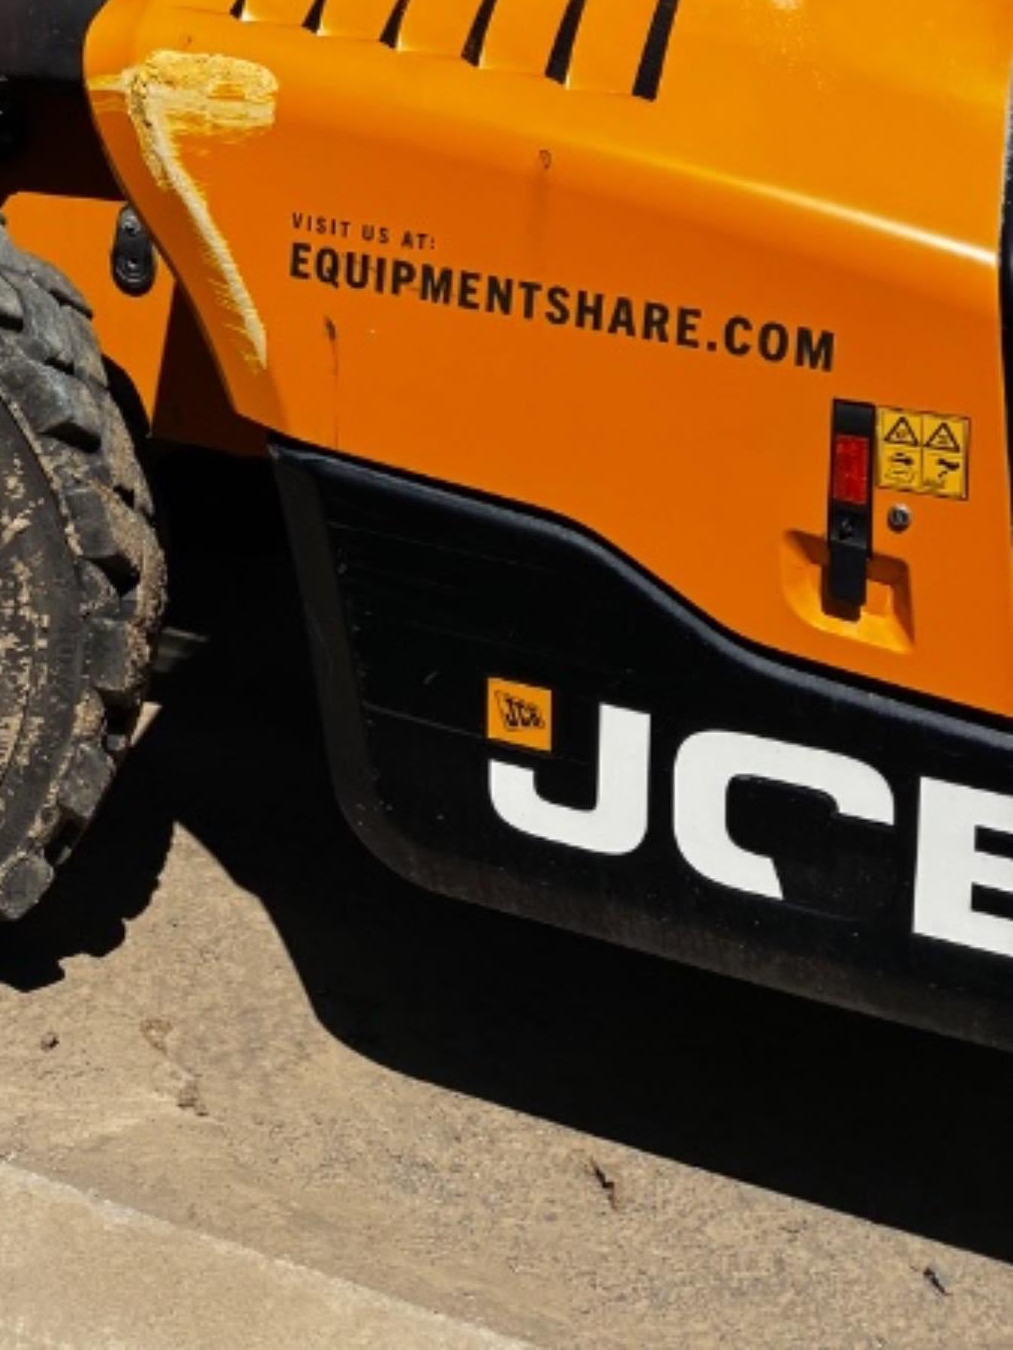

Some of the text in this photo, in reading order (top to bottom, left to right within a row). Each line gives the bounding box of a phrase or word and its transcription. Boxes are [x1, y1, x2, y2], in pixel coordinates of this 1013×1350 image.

[292, 212, 435, 250] VISIT US AT:
[290, 242, 836, 372] EQUIPMENTSHARE.COM
